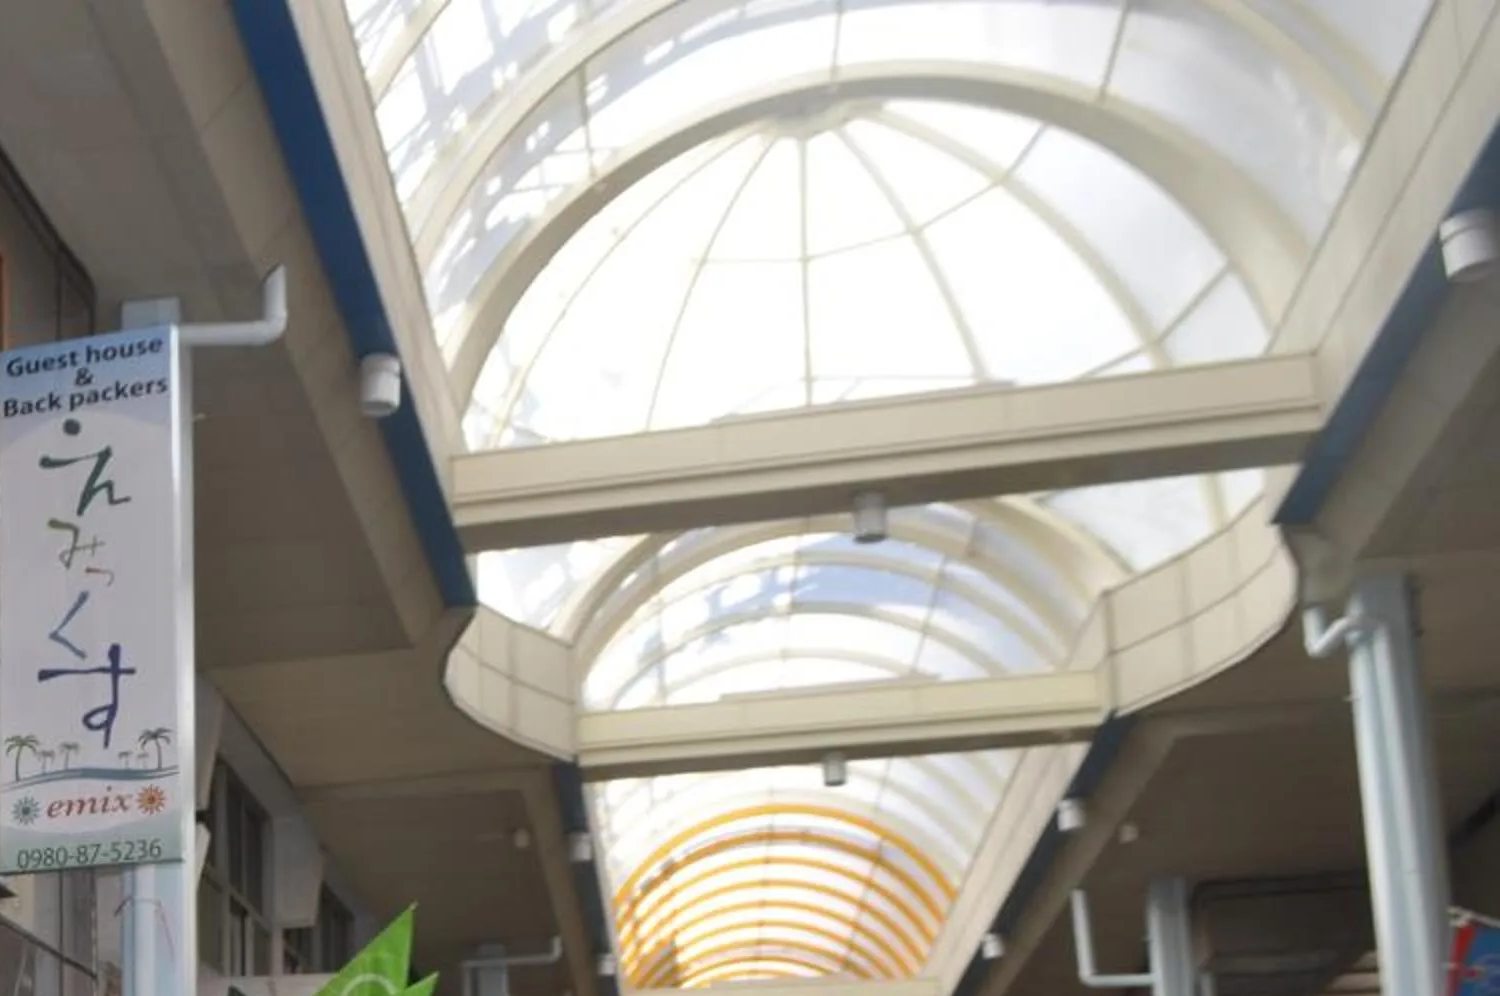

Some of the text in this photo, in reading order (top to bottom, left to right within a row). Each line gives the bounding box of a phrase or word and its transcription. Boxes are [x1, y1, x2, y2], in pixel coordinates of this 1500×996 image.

[6, 338, 163, 378] Guest house
[74, 367, 94, 386] &
[3, 377, 168, 418] Back packers
[46, 785, 133, 818] emix
[17, 838, 163, 870] 0980-87-5236
